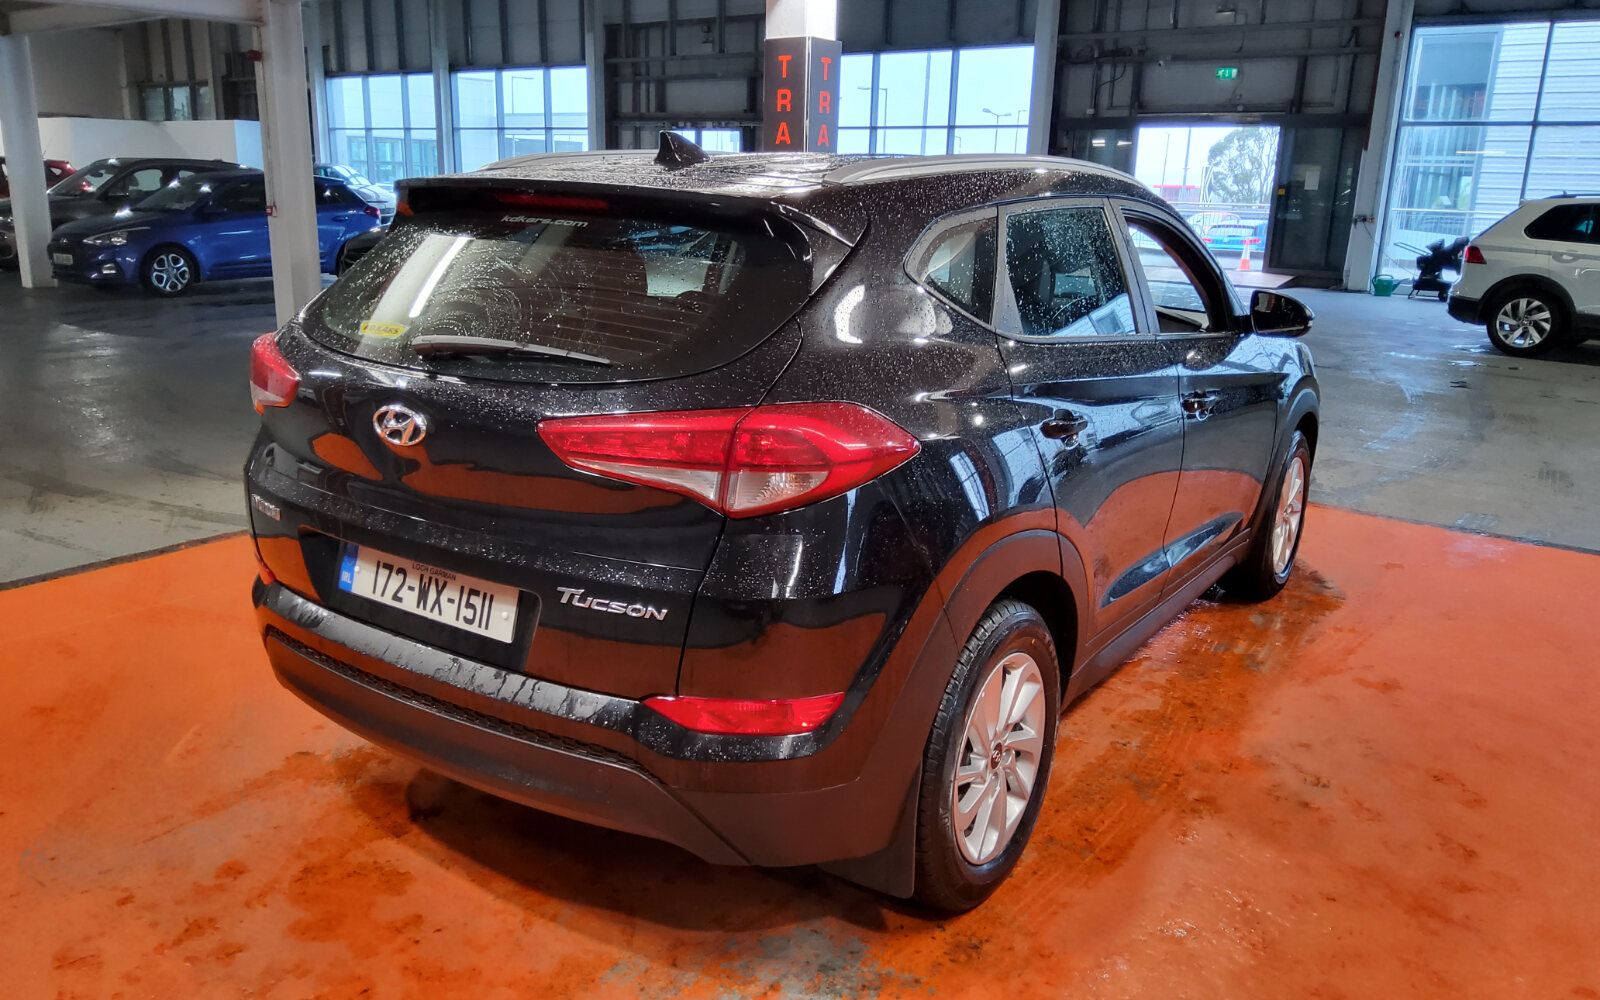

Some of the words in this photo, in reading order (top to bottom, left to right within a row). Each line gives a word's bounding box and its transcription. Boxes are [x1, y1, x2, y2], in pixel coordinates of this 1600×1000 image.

[501, 215, 589, 228] kdkars.com
[341, 570, 352, 584] IRL
[412, 562, 430, 574] LOCH
[429, 567, 457, 581] GARMAN
[372, 560, 494, 630] 172-WX-1511
[556, 586, 668, 621] TUCSON
